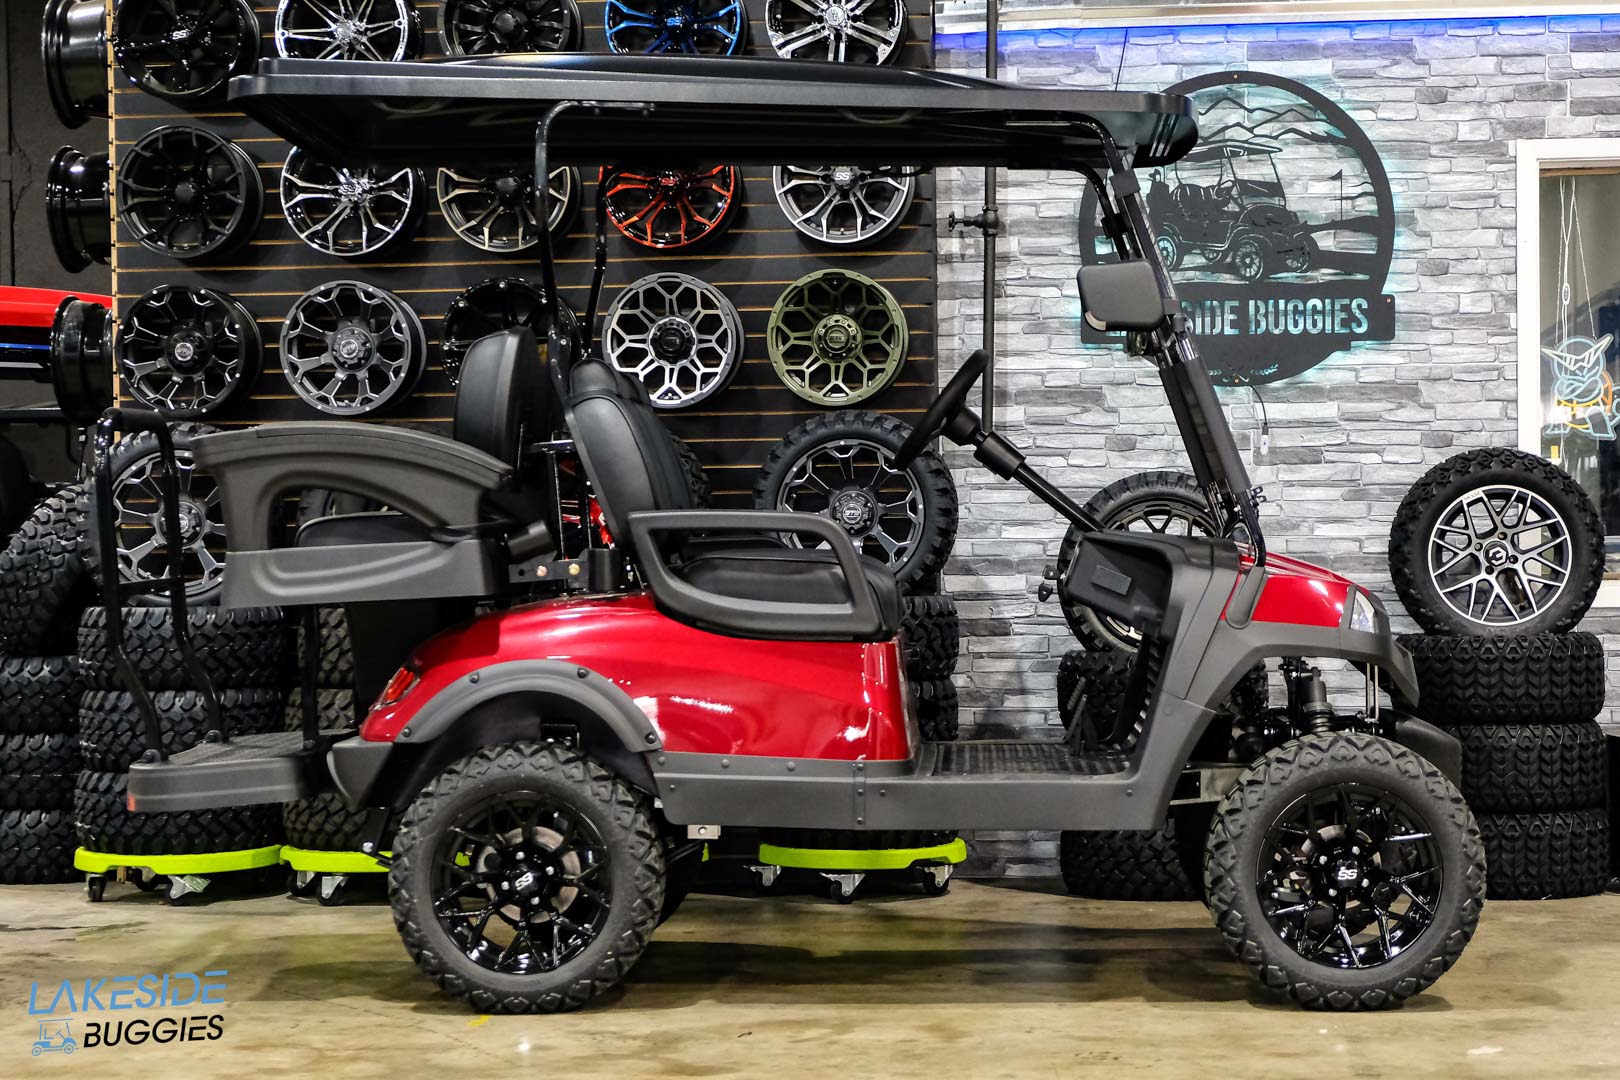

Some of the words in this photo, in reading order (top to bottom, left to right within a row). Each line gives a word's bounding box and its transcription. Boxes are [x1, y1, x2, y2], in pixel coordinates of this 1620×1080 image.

[172, 29, 187, 40] SS
[835, 172, 850, 181] SS
[1248, 298, 1368, 334] BUGGIES
[1337, 869, 1357, 880] SS
[515, 872, 533, 890] SS
